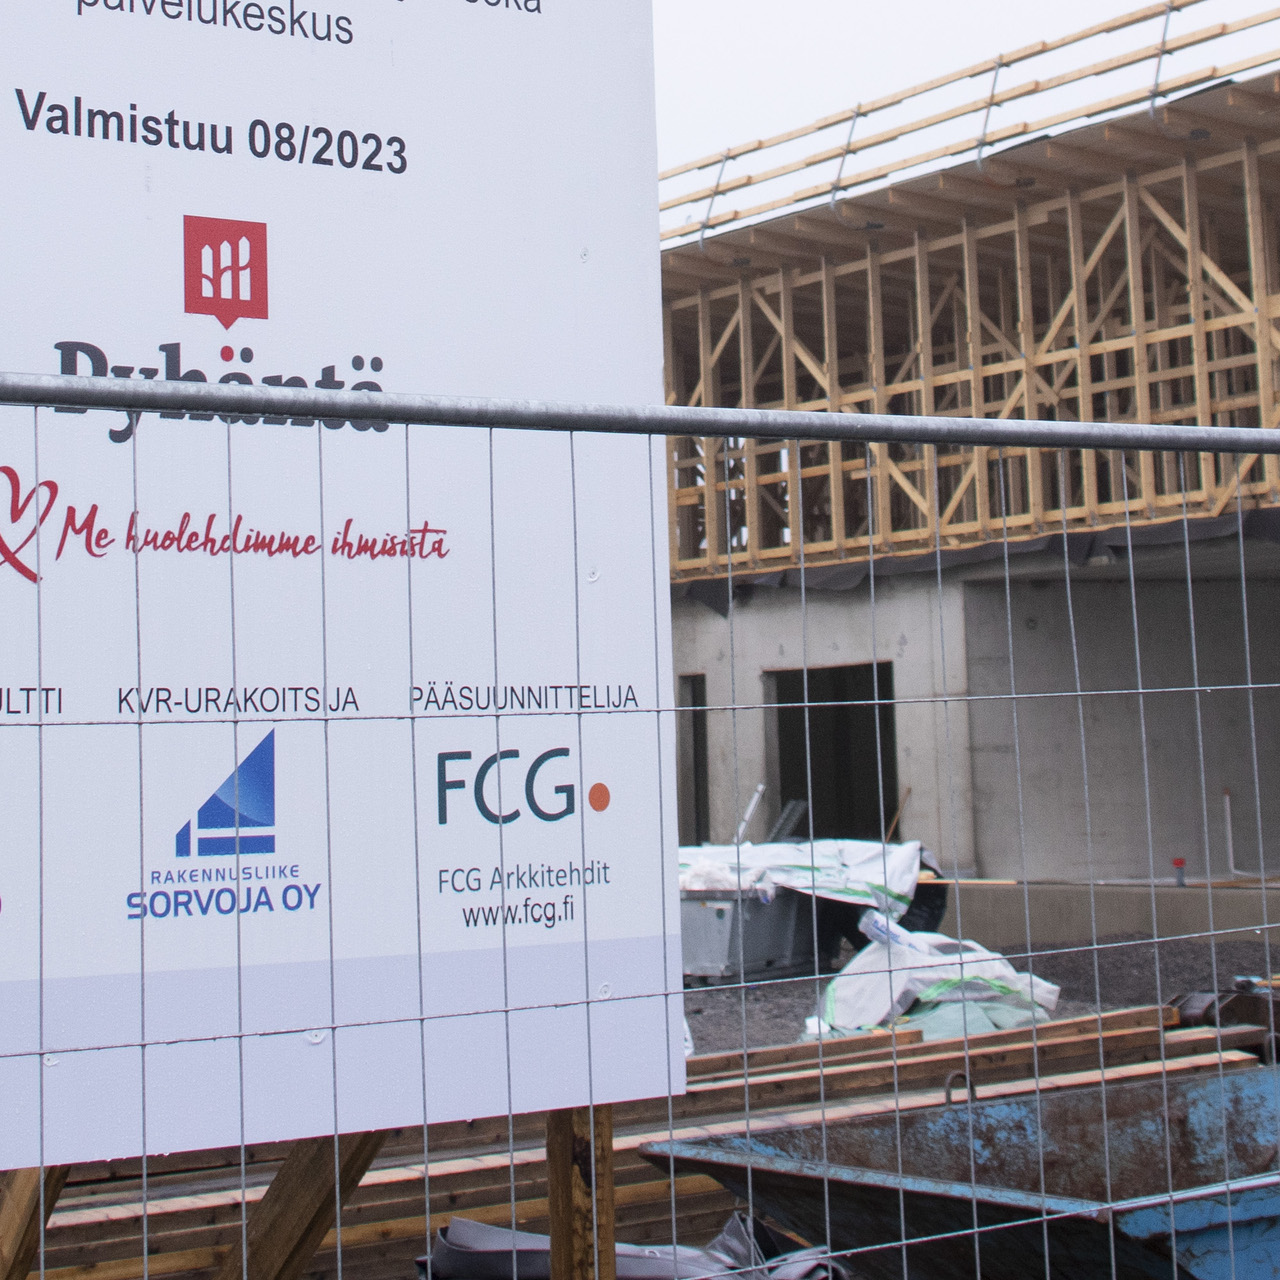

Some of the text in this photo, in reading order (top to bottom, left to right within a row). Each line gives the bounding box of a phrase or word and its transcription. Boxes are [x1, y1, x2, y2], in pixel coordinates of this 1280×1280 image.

[15, 88, 409, 175] Valmistuu 08/2023
[55, 503, 116, 561] Me
[125, 511, 321, 558] huolehdimme
[409, 681, 639, 711] PÄÄSUUNNITTELIJA
[437, 747, 575, 825] FCG
[150, 863, 301, 886] RAKENNUSLIIKE
[438, 860, 611, 894] FCG Arkkitehdit
[126, 882, 322, 920] SORVOJA OY
[462, 895, 575, 930] www.fcg.fi
